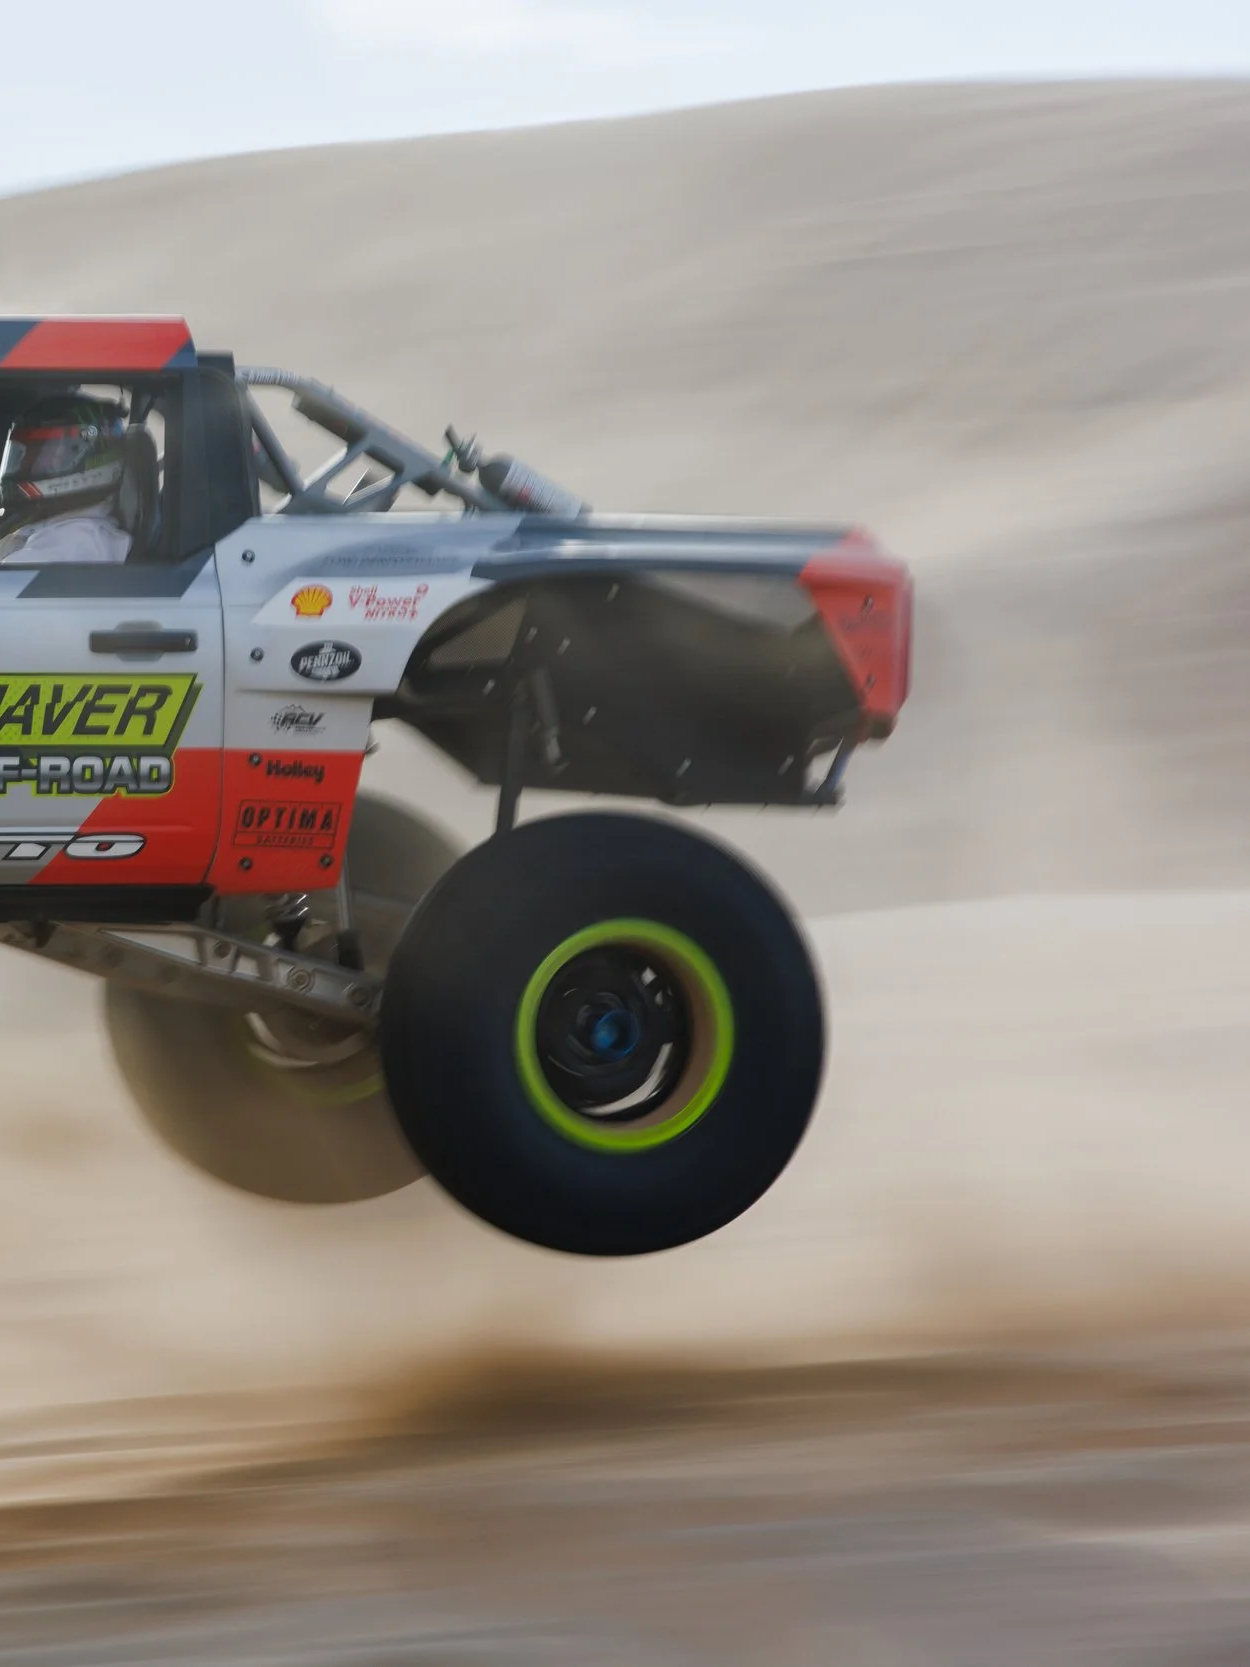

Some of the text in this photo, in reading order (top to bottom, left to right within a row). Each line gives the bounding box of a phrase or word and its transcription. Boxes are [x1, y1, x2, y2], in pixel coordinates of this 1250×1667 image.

[299, 650, 351, 669] PENNZOIL
[266, 760, 325, 783] Holley
[241, 806, 334, 832] OPTIMA
